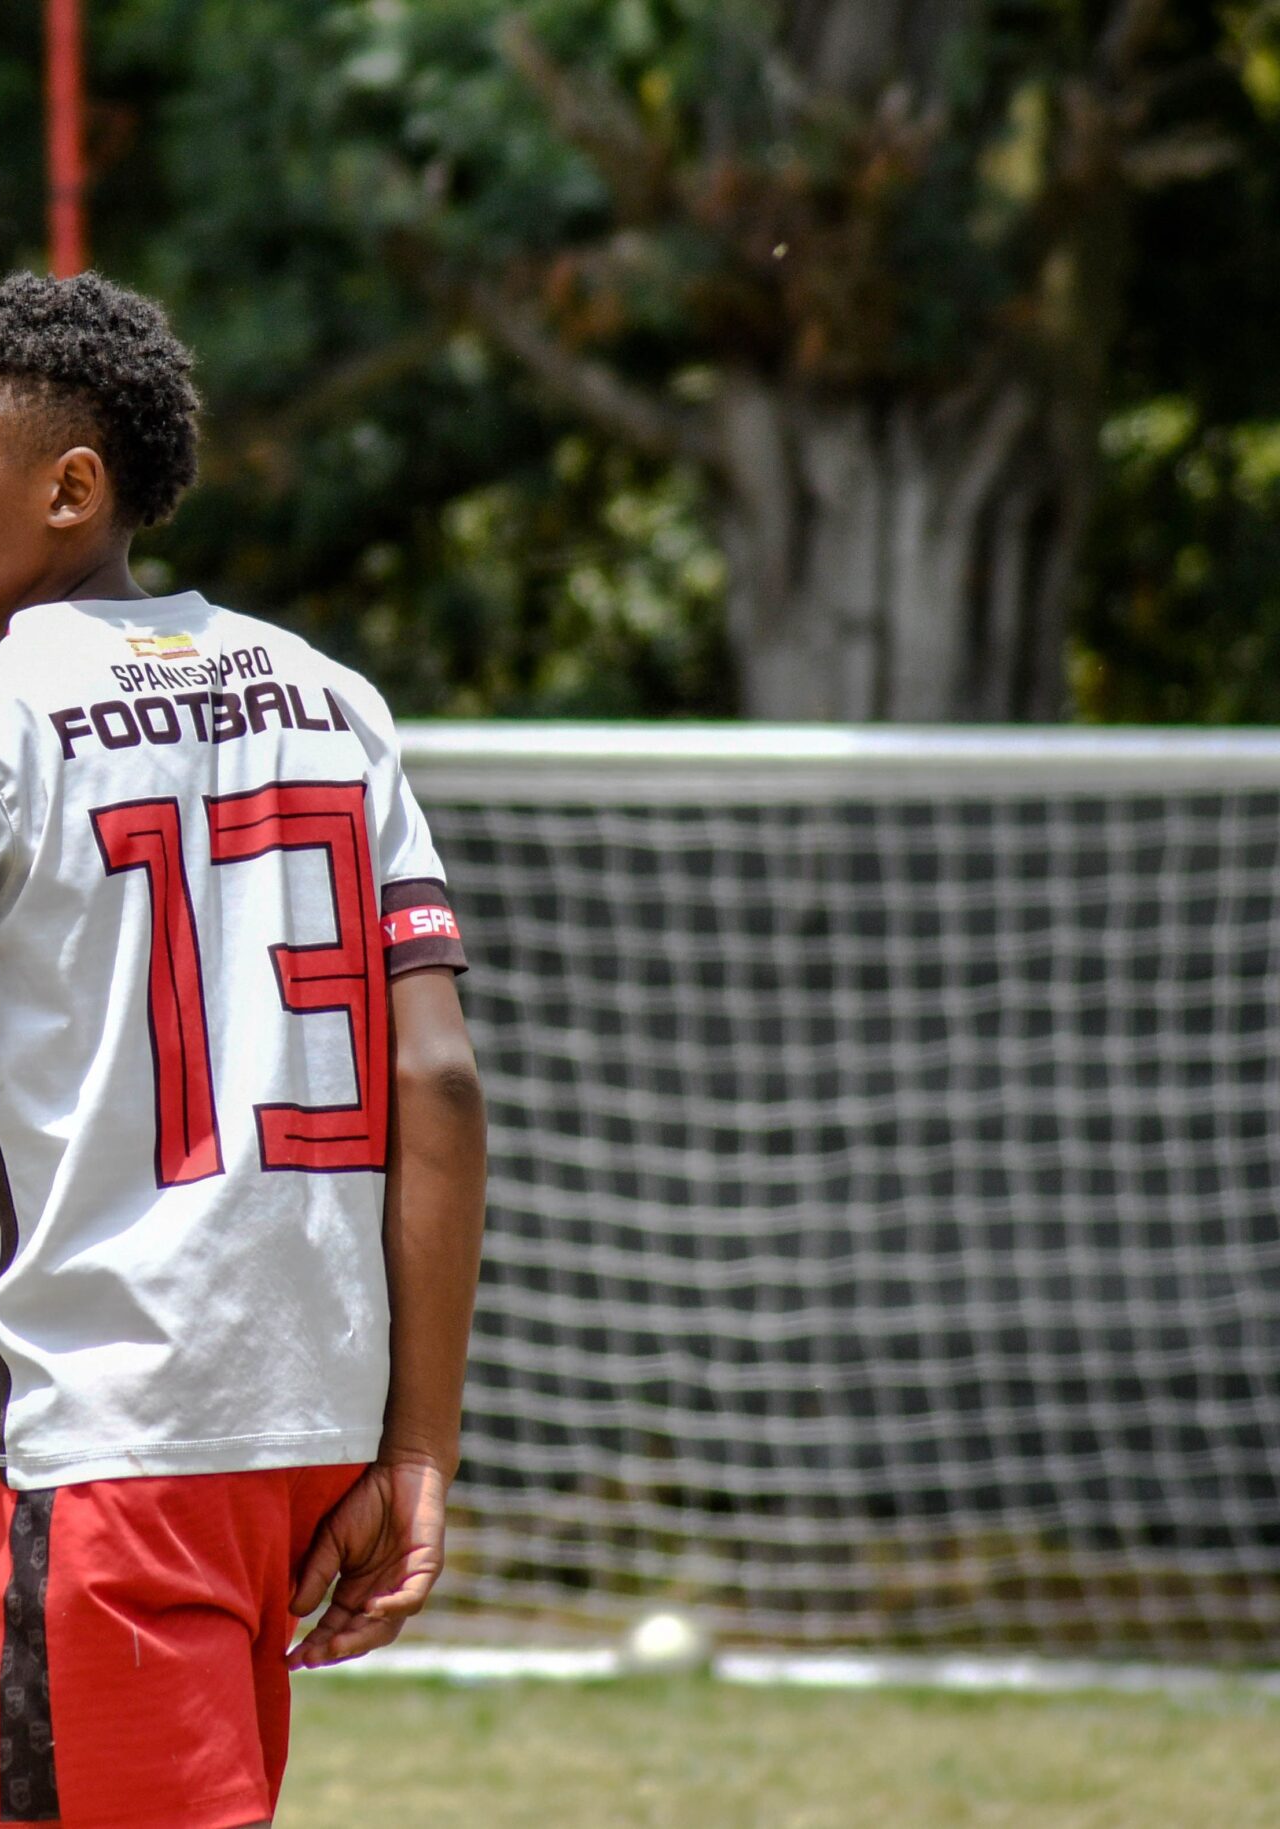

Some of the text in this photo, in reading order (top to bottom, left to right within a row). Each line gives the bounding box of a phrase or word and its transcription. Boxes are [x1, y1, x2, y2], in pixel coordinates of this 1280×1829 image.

[111, 646, 273, 692] SPANISH PRO
[409, 908, 456, 935] SPF
[88, 778, 389, 1190] 13
